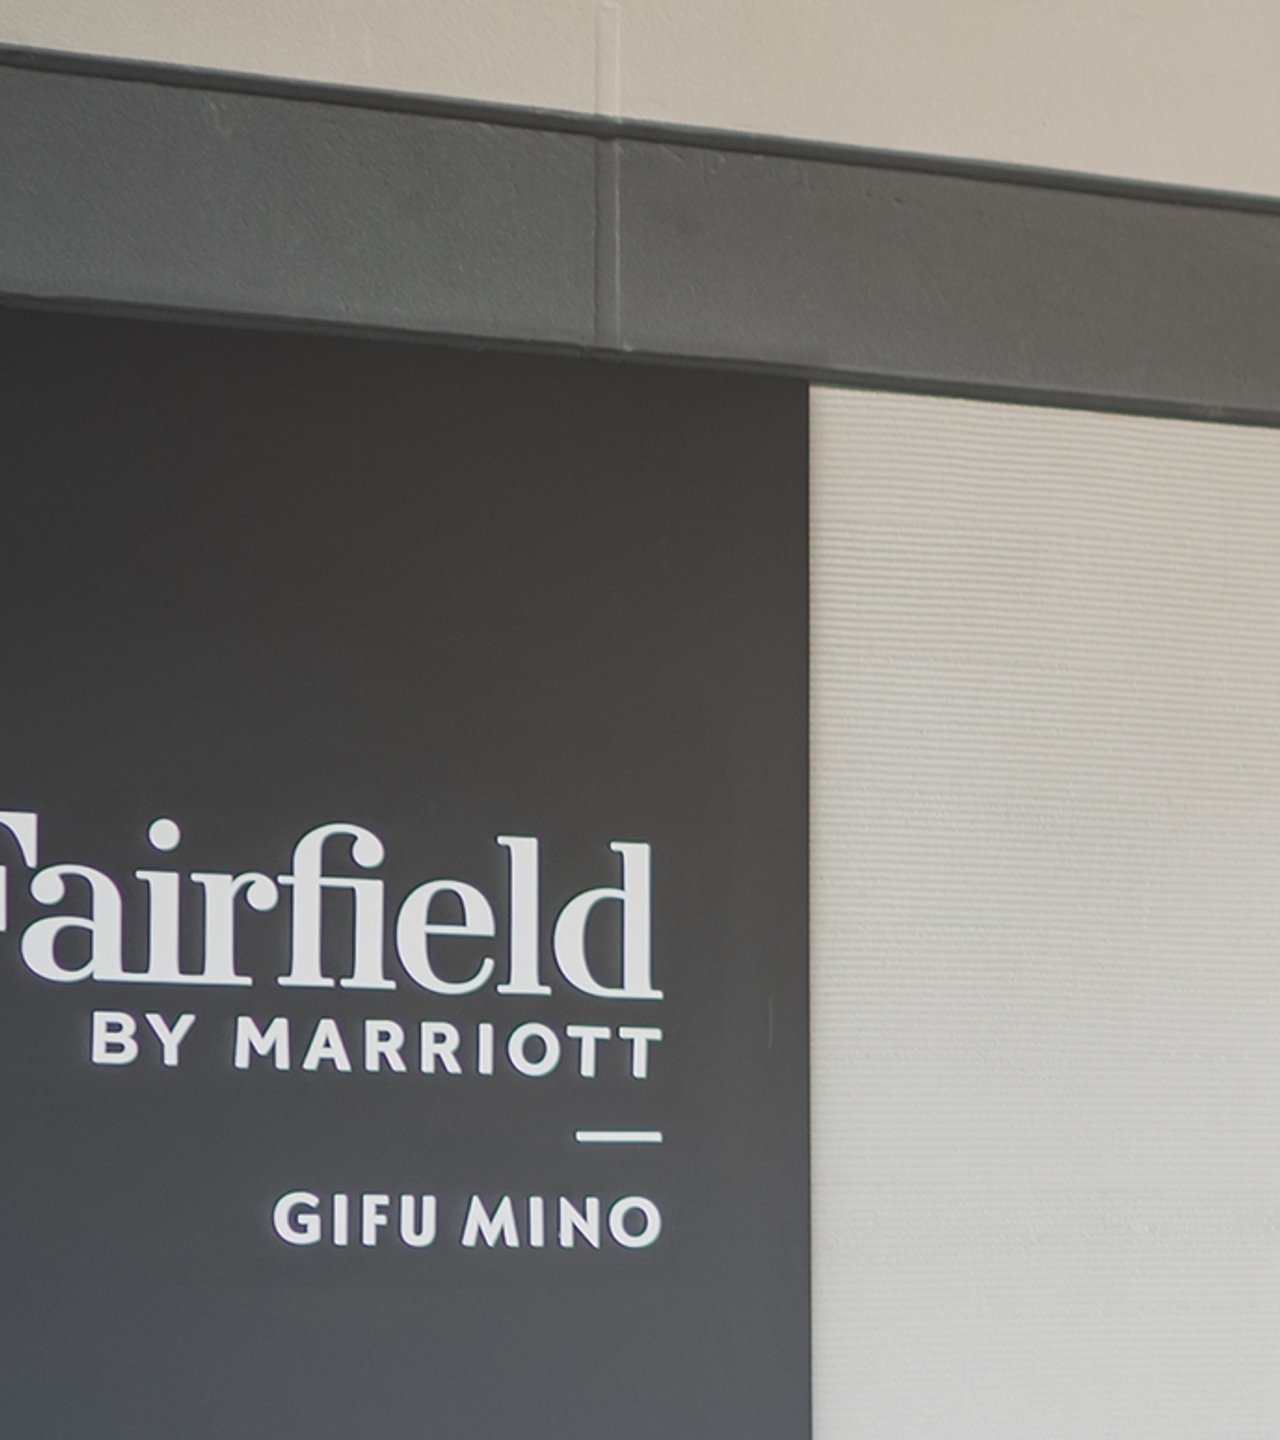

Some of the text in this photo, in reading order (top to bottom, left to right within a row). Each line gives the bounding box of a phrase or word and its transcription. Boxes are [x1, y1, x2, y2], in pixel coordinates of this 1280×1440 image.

[91, 1010, 663, 1079] BY MARRIOTT
[273, 1191, 662, 1249] GIFU MINO
